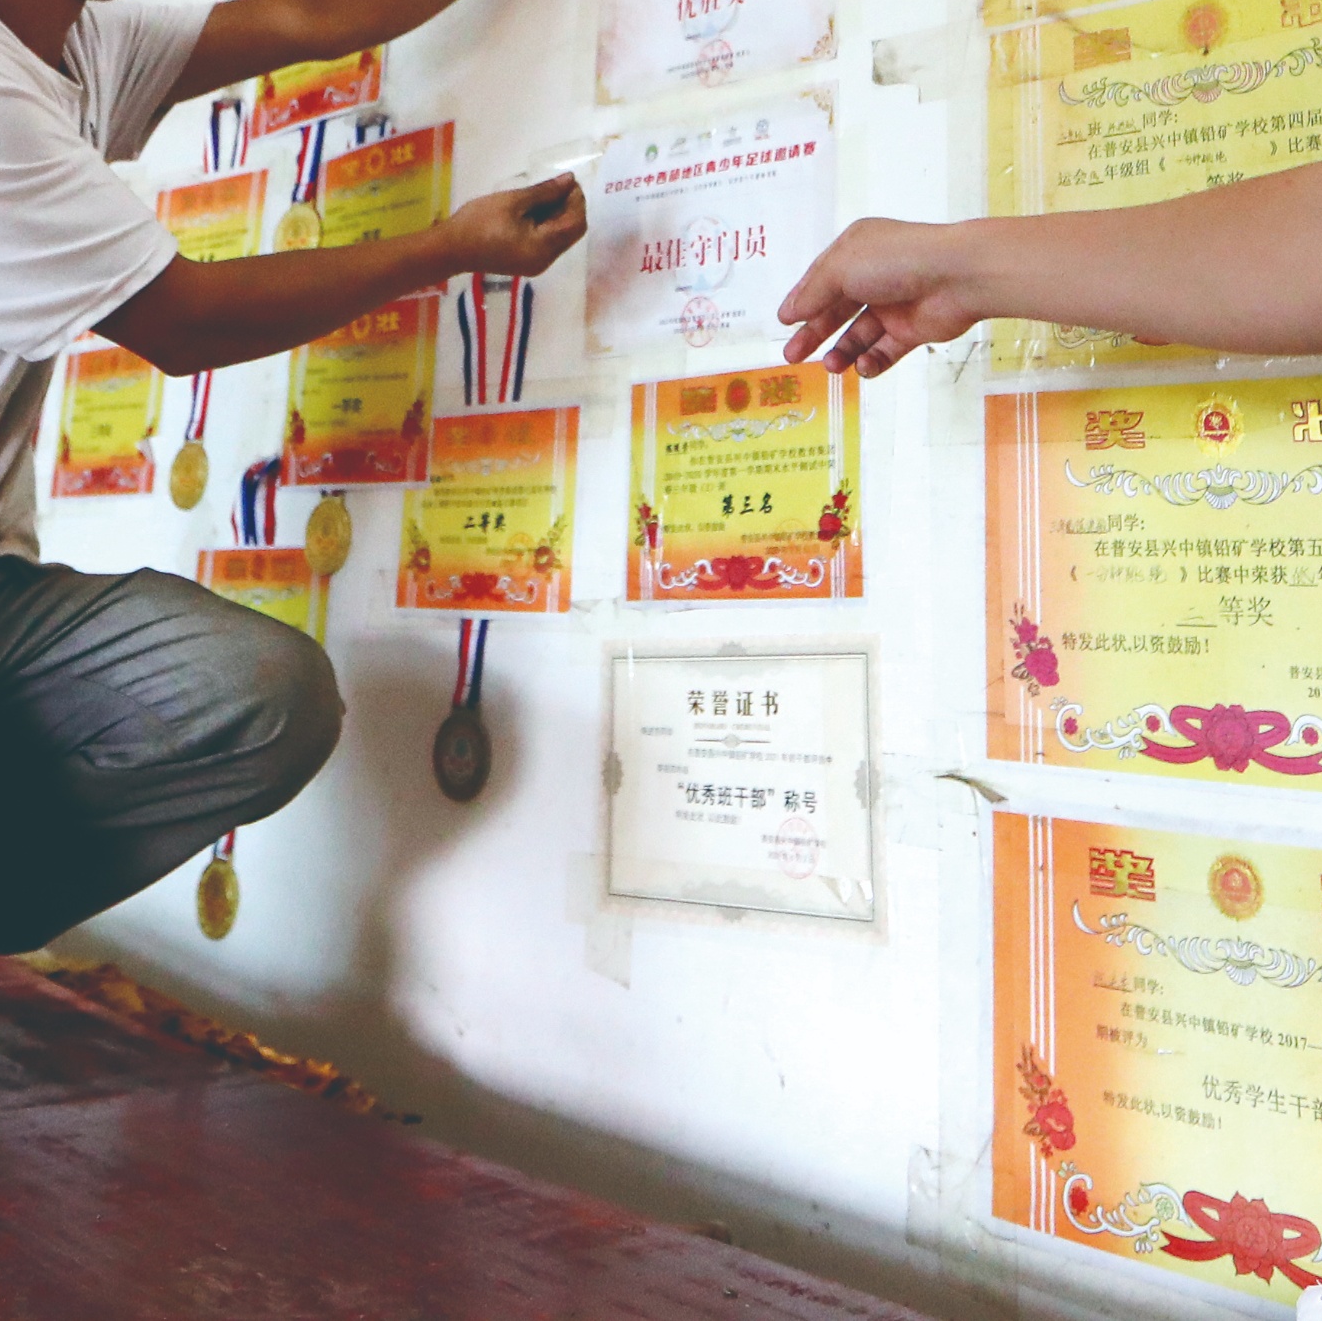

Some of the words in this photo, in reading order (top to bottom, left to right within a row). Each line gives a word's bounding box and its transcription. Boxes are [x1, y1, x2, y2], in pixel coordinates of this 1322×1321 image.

[604, 141, 817, 194] 2022中西部地区青少年足球邀请赛
[639, 225, 767, 274] 最佳守门员
[721, 492, 774, 517] 第三名
[687, 689, 779, 717] 荣誉证书
